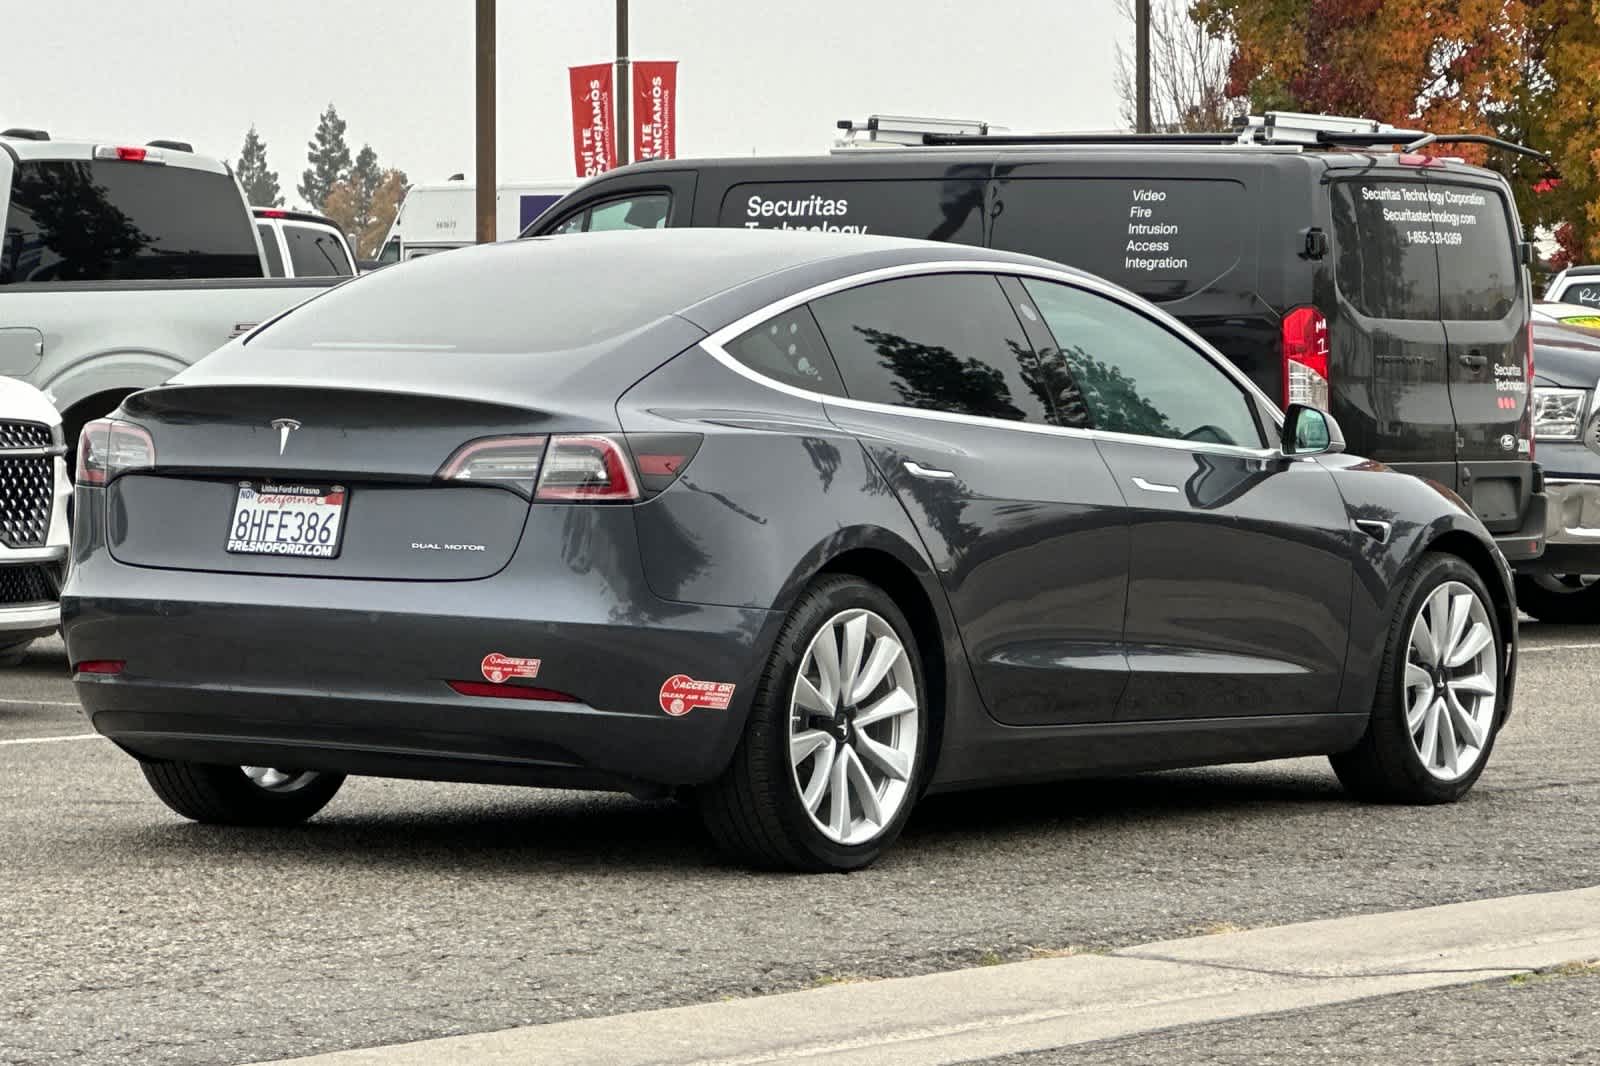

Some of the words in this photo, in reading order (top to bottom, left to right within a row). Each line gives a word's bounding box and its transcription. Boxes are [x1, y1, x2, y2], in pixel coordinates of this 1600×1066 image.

[583, 127, 593, 148] TE
[642, 122, 652, 144] TE
[1133, 189, 1167, 201] Video
[1361, 187, 1400, 201] Securitas
[747, 194, 848, 216] Securitas
[1130, 205, 1152, 218] Fire
[1128, 222, 1178, 235] Intrusion
[1126, 240, 1169, 252] Access
[1125, 256, 1188, 271] Integration
[240, 490, 255, 499] NOV
[279, 485, 292, 494] Ford
[292, 486, 299, 494] of
[300, 486, 320, 495] Fresno
[235, 508, 335, 544] 8HFE386
[227, 540, 333, 556] FRESNOFORD.COM
[679, 681, 716, 691] ACCESS
[717, 684, 732, 693] OK
